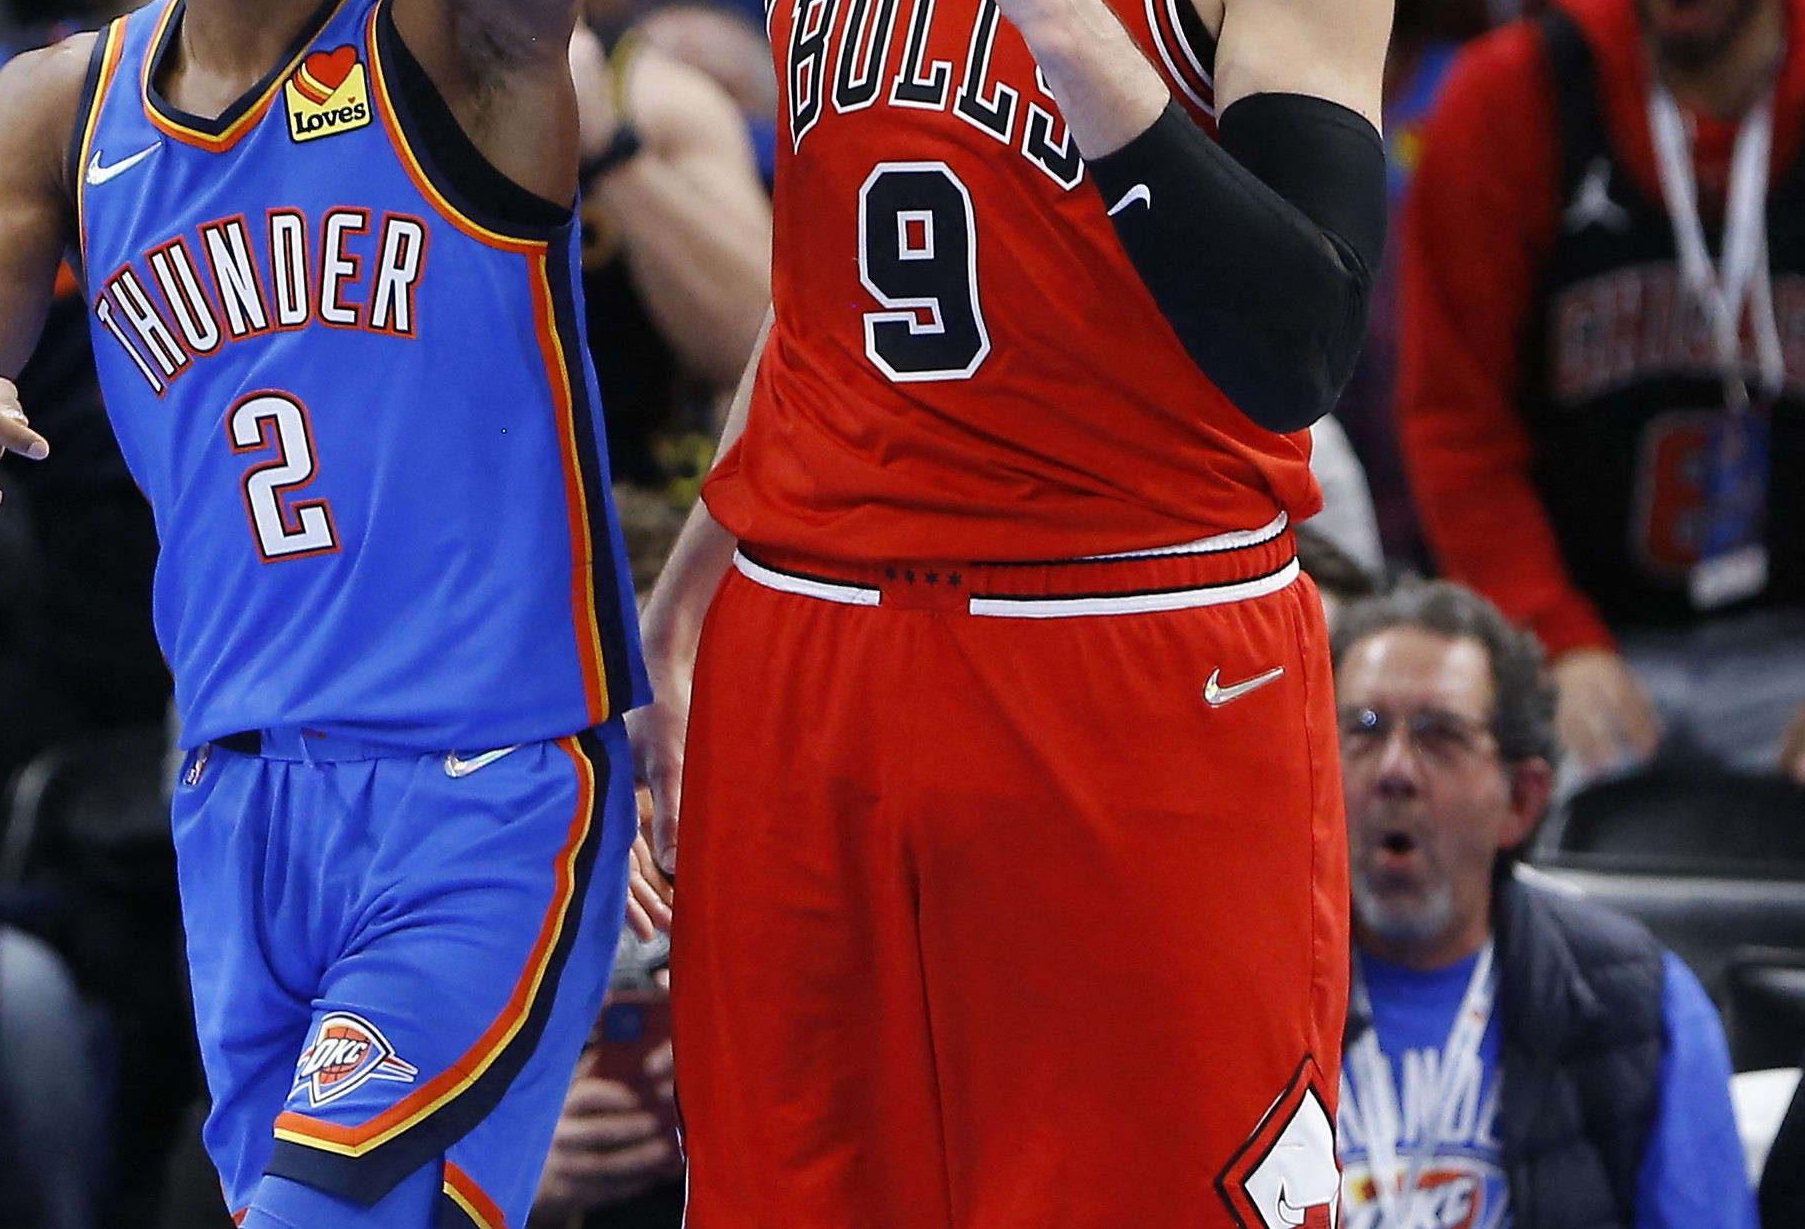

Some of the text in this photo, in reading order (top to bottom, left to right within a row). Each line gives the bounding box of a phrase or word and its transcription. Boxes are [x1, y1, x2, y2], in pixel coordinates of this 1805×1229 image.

[293, 102, 366, 135] Loves
[95, 205, 427, 398] THUNDER
[858, 161, 992, 382] 9
[225, 388, 342, 564] 2
[300, 1038, 369, 1078] OKC
